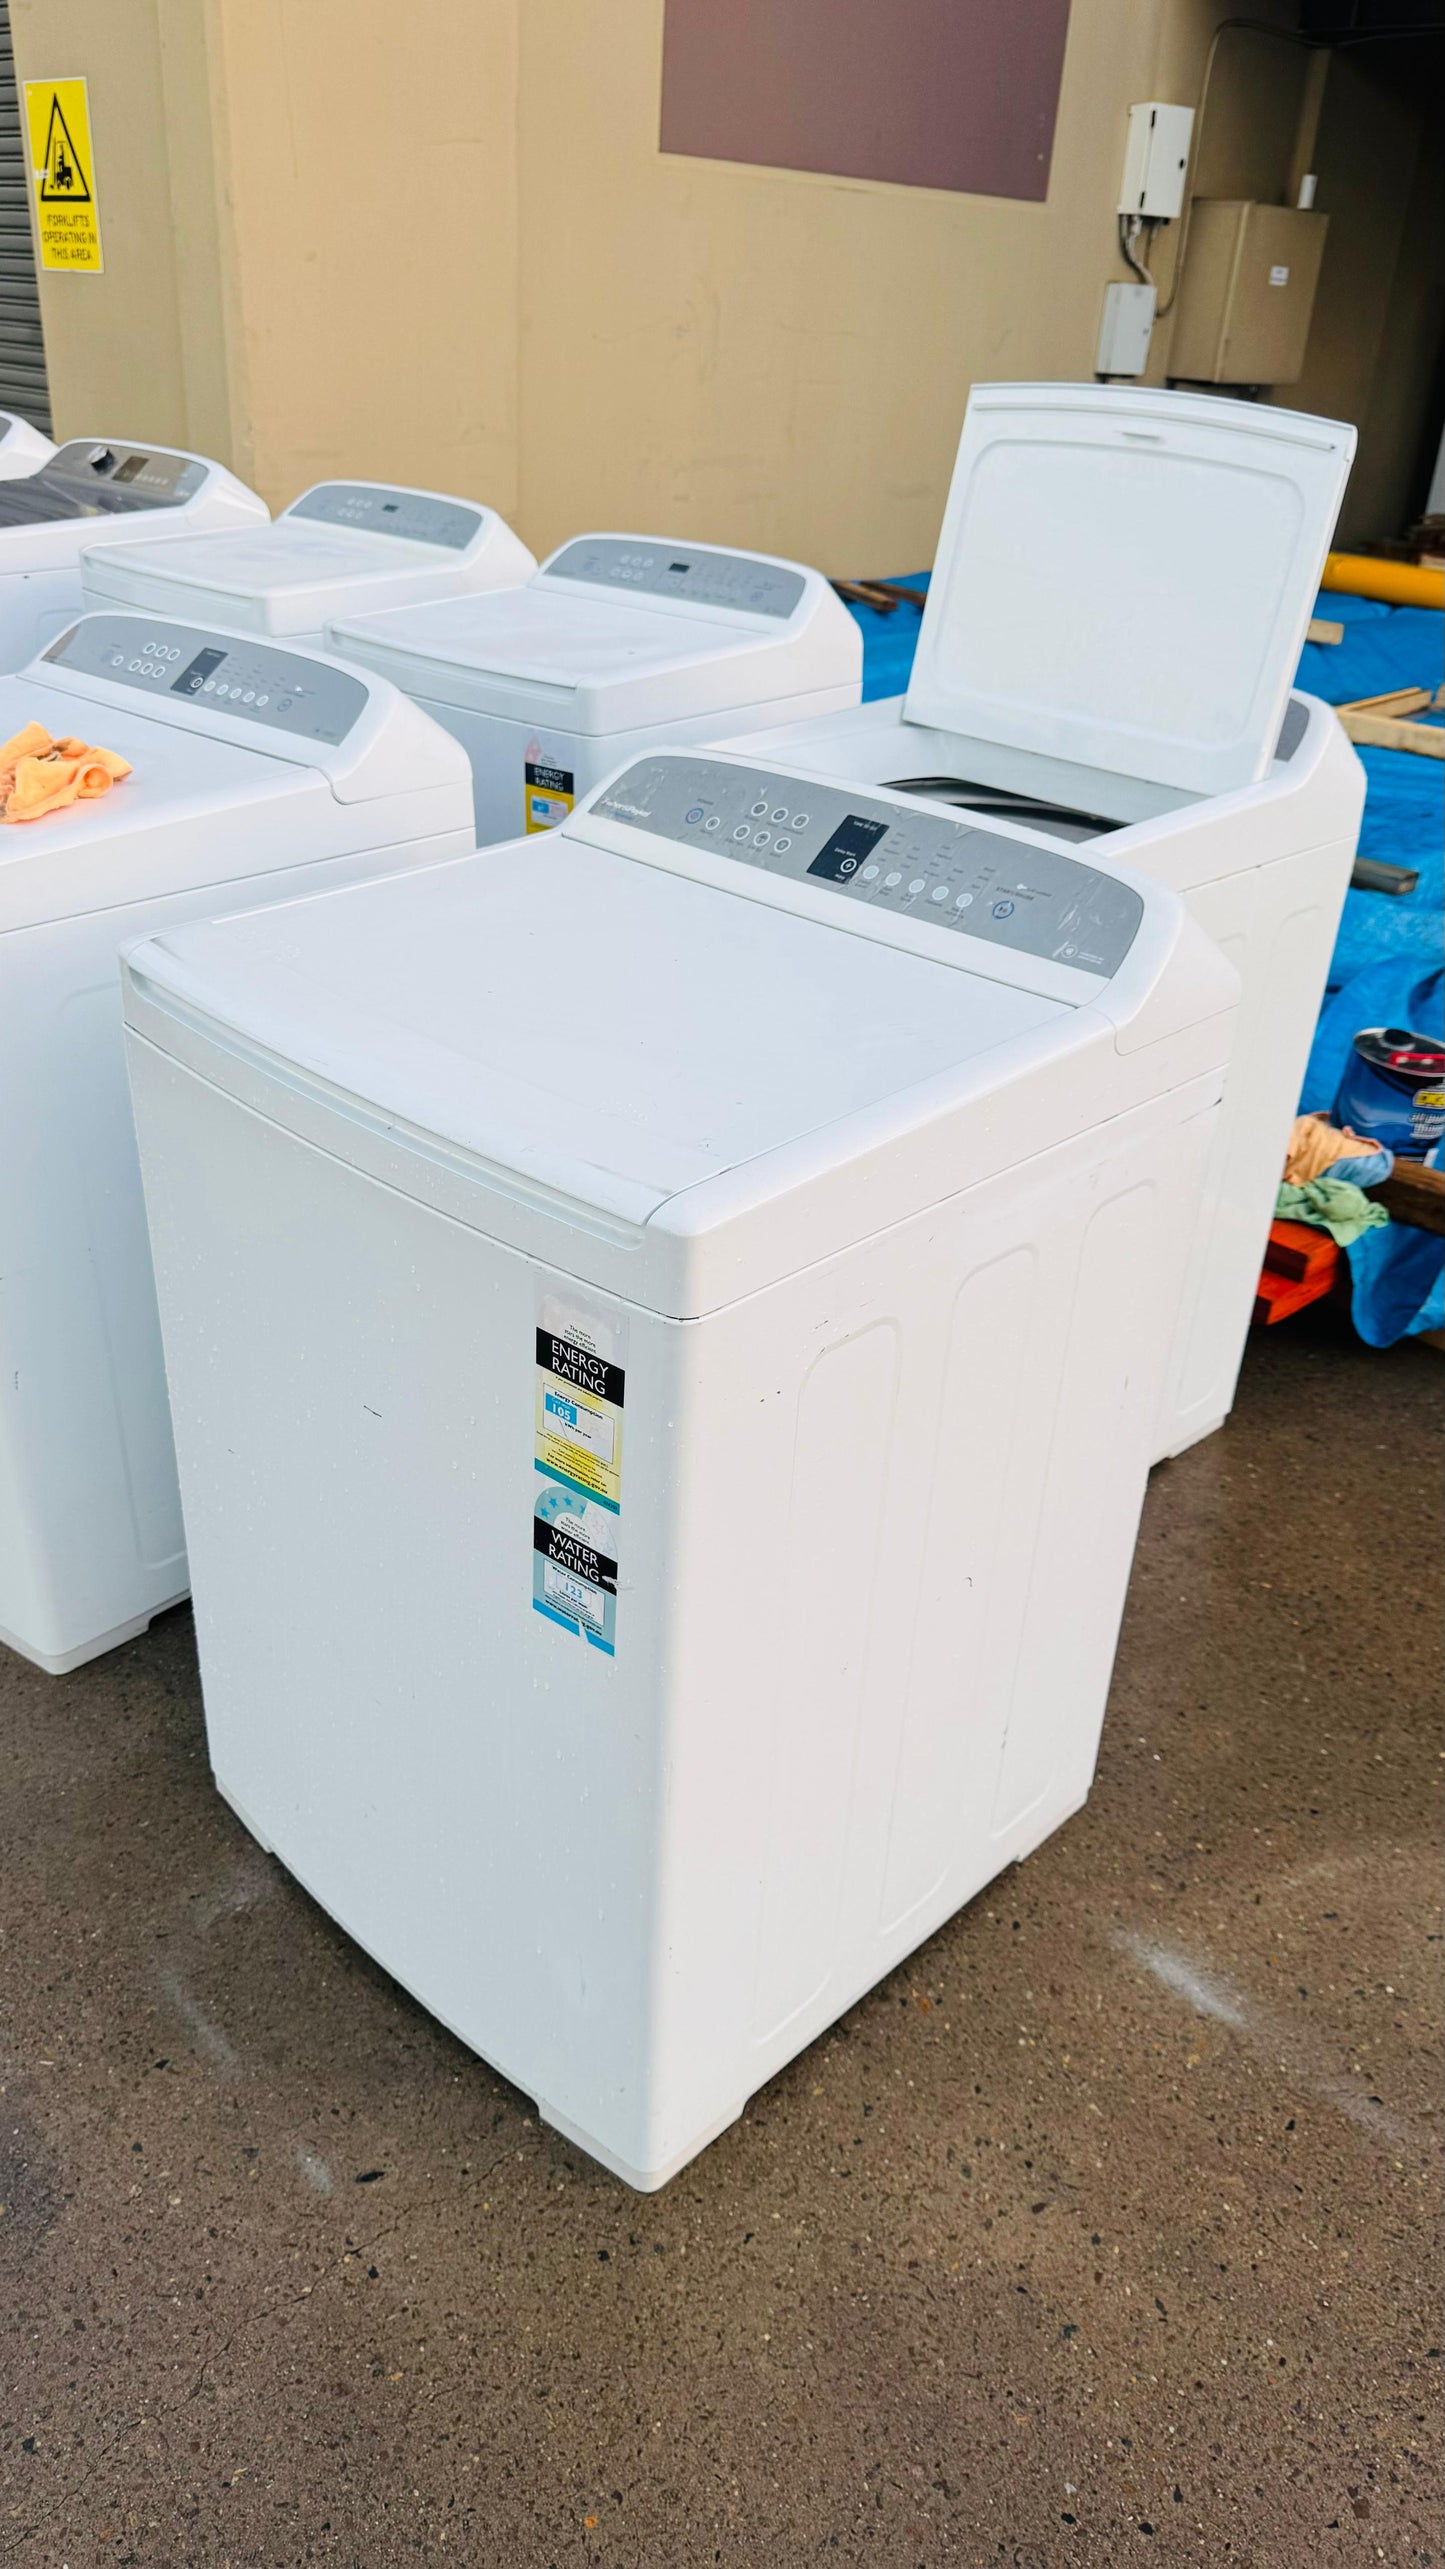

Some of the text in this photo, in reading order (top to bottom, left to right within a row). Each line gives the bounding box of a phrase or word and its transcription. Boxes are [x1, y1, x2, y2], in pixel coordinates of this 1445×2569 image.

[47, 214, 90, 227] FORKLIFTS
[43, 231, 97, 244] OPERATING IN
[51, 247, 92, 261] THIS AREA
[534, 767, 565, 780] ENERGY
[534, 777, 564, 792] RATING
[552, 1339, 609, 1378] ENERGY
[552, 1356, 606, 1395] RATING
[552, 1402, 571, 1421] 105
[554, 1391, 604, 1420] Energy Consumption
[551, 1529, 599, 1568] WATER
[548, 1543, 600, 1583] RATING
[565, 1582, 583, 1600] 123
